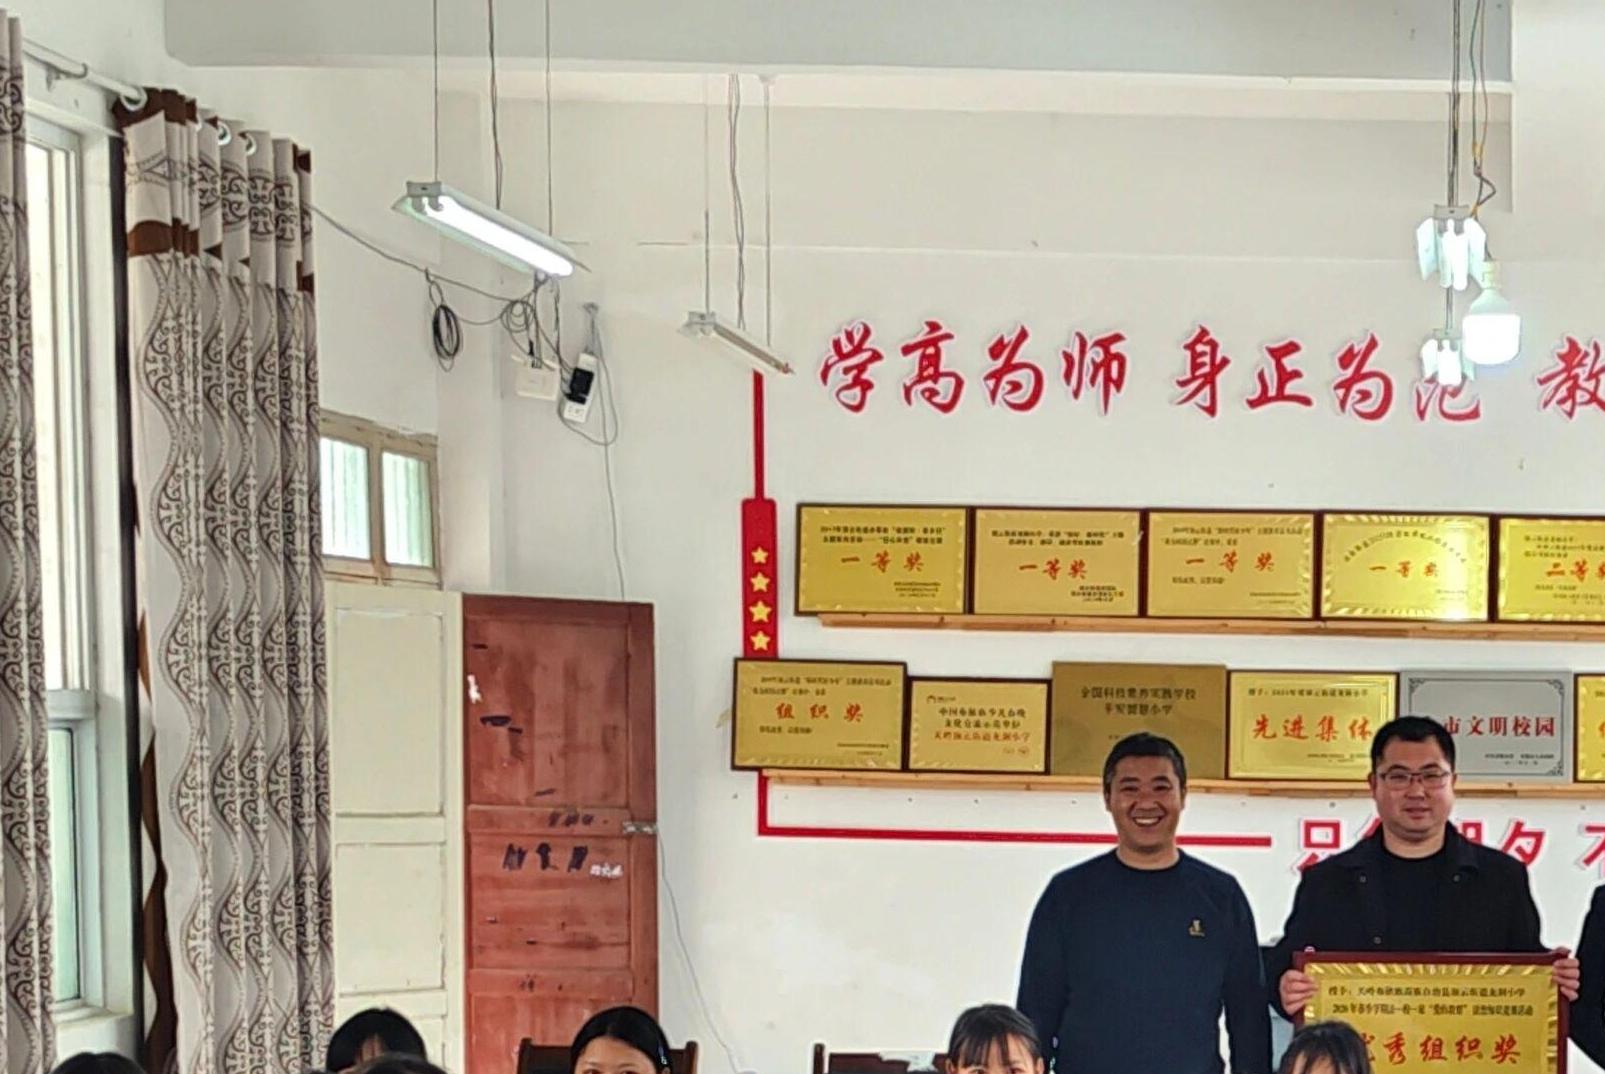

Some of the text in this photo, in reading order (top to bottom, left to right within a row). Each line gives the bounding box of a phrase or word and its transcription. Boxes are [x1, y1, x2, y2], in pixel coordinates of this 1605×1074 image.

[818, 318, 1129, 416] 学高为师
[841, 550, 924, 573] 一等奖
[1019, 558, 1087, 580] 一等奖
[1186, 550, 1274, 573] 一等奖
[1369, 561, 1438, 578] 一等奖
[776, 703, 863, 722] 组织奖
[1252, 714, 1373, 742] 先进集体
[1443, 715, 1555, 737] 市文明校园
